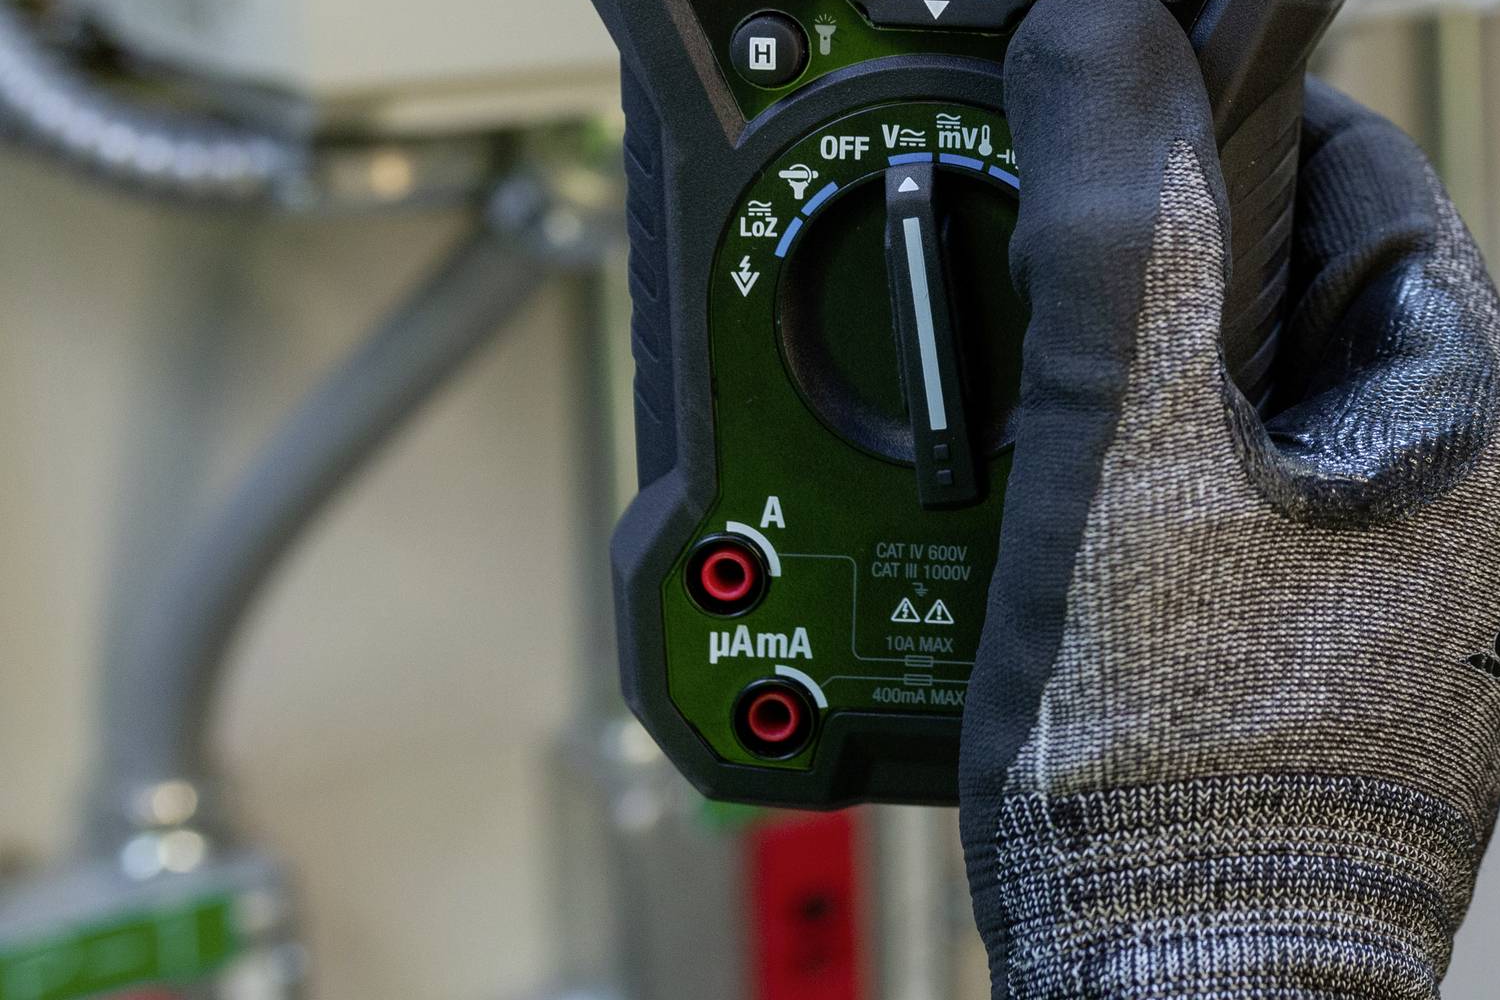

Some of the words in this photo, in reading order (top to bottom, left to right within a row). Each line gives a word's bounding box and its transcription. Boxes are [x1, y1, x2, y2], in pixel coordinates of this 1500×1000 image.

[755, 43, 772, 64] H
[820, 135, 870, 160] OFF
[938, 127, 978, 150] mV
[740, 217, 778, 237] LoZ
[760, 496, 786, 529] A
[876, 542, 905, 558] CAT
[910, 544, 923, 559] IV
[928, 545, 967, 561] 600V
[871, 561, 900, 577] CAT
[906, 563, 917, 578] III
[924, 564, 971, 581] 1000V
[709, 625, 813, 664] µAmA
[886, 636, 914, 651] 10A
[919, 637, 953, 652] MAX
[872, 687, 926, 704] 400mA
[931, 689, 965, 705] MAX
